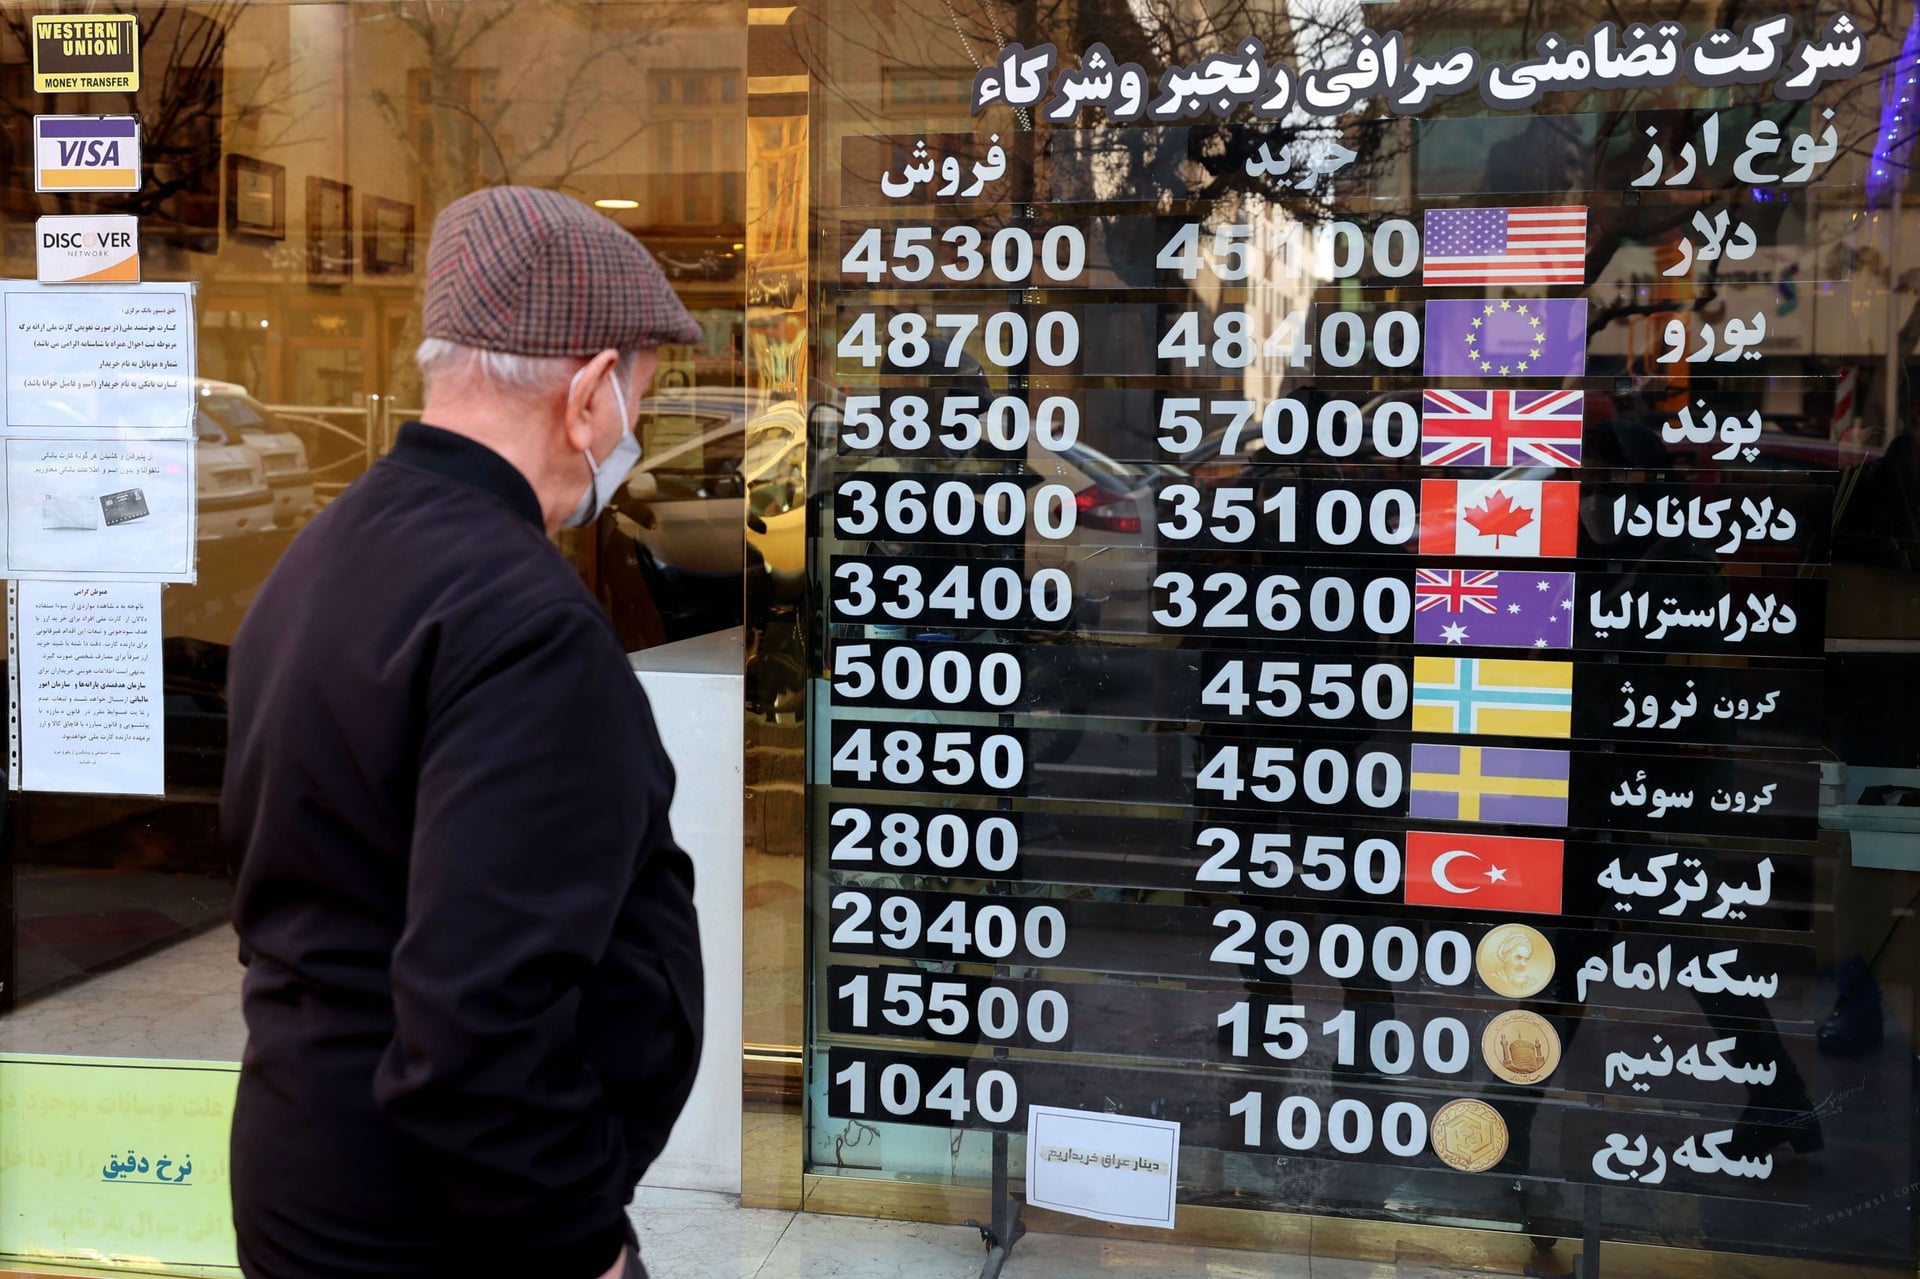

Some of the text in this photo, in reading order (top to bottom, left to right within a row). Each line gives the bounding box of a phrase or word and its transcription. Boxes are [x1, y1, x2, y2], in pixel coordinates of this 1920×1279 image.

[38, 22, 117, 39] WESTERN
[63, 39, 117, 56] UNION
[1694, 15, 1861, 88] شرکت
[45, 77, 129, 88] MONEY TRANSFER
[1156, 43, 1290, 114] رنجبر
[1306, 34, 1474, 107] صرافی
[1488, 26, 1679, 100] تضامنی
[56, 140, 120, 166] VISA
[881, 134, 1007, 198] فروش
[1245, 130, 1359, 191] خرید
[1630, 109, 1839, 187] نوع ارز
[842, 225, 1086, 283] 45300
[1155, 219, 1420, 281] 45100
[1662, 209, 1758, 276] دلار
[837, 311, 1080, 368] 48700
[1157, 310, 1420, 368] 48400
[1656, 312, 1766, 363] یورو
[841, 395, 1080, 451] 58500
[1157, 397, 1419, 458] 57000
[1661, 399, 1762, 463] پوند
[836, 480, 1077, 539] 36000
[1157, 484, 1416, 546] 35100
[834, 562, 1073, 621] 33400
[1152, 571, 1411, 634] 32600
[832, 644, 1022, 706] 5000
[1201, 659, 1408, 720] 4550
[1612, 680, 1781, 729] کرون نروژ
[832, 728, 1024, 789] 4850
[1196, 745, 1403, 808] 4500
[1610, 770, 1777, 818] کرون سوئد
[831, 808, 1018, 871] 2800
[1195, 827, 1401, 895] 2550
[832, 891, 1066, 959] 29400
[1210, 909, 1472, 986] 29000
[1576, 940, 1778, 1003] سکه امام
[838, 973, 1069, 1043] 15500
[1217, 1001, 1470, 1074] 15100
[835, 1061, 1018, 1122] 1040
[1604, 1034, 1777, 1092] سکه نیم
[1229, 1091, 1428, 1157] 1000
[103, 1150, 149, 1179] دقیق
[156, 1154, 192, 1182] نرخ
[1046, 1148, 1159, 1172] دینار عراق خریداریم
[1591, 1129, 1773, 1184] سکه ربع
